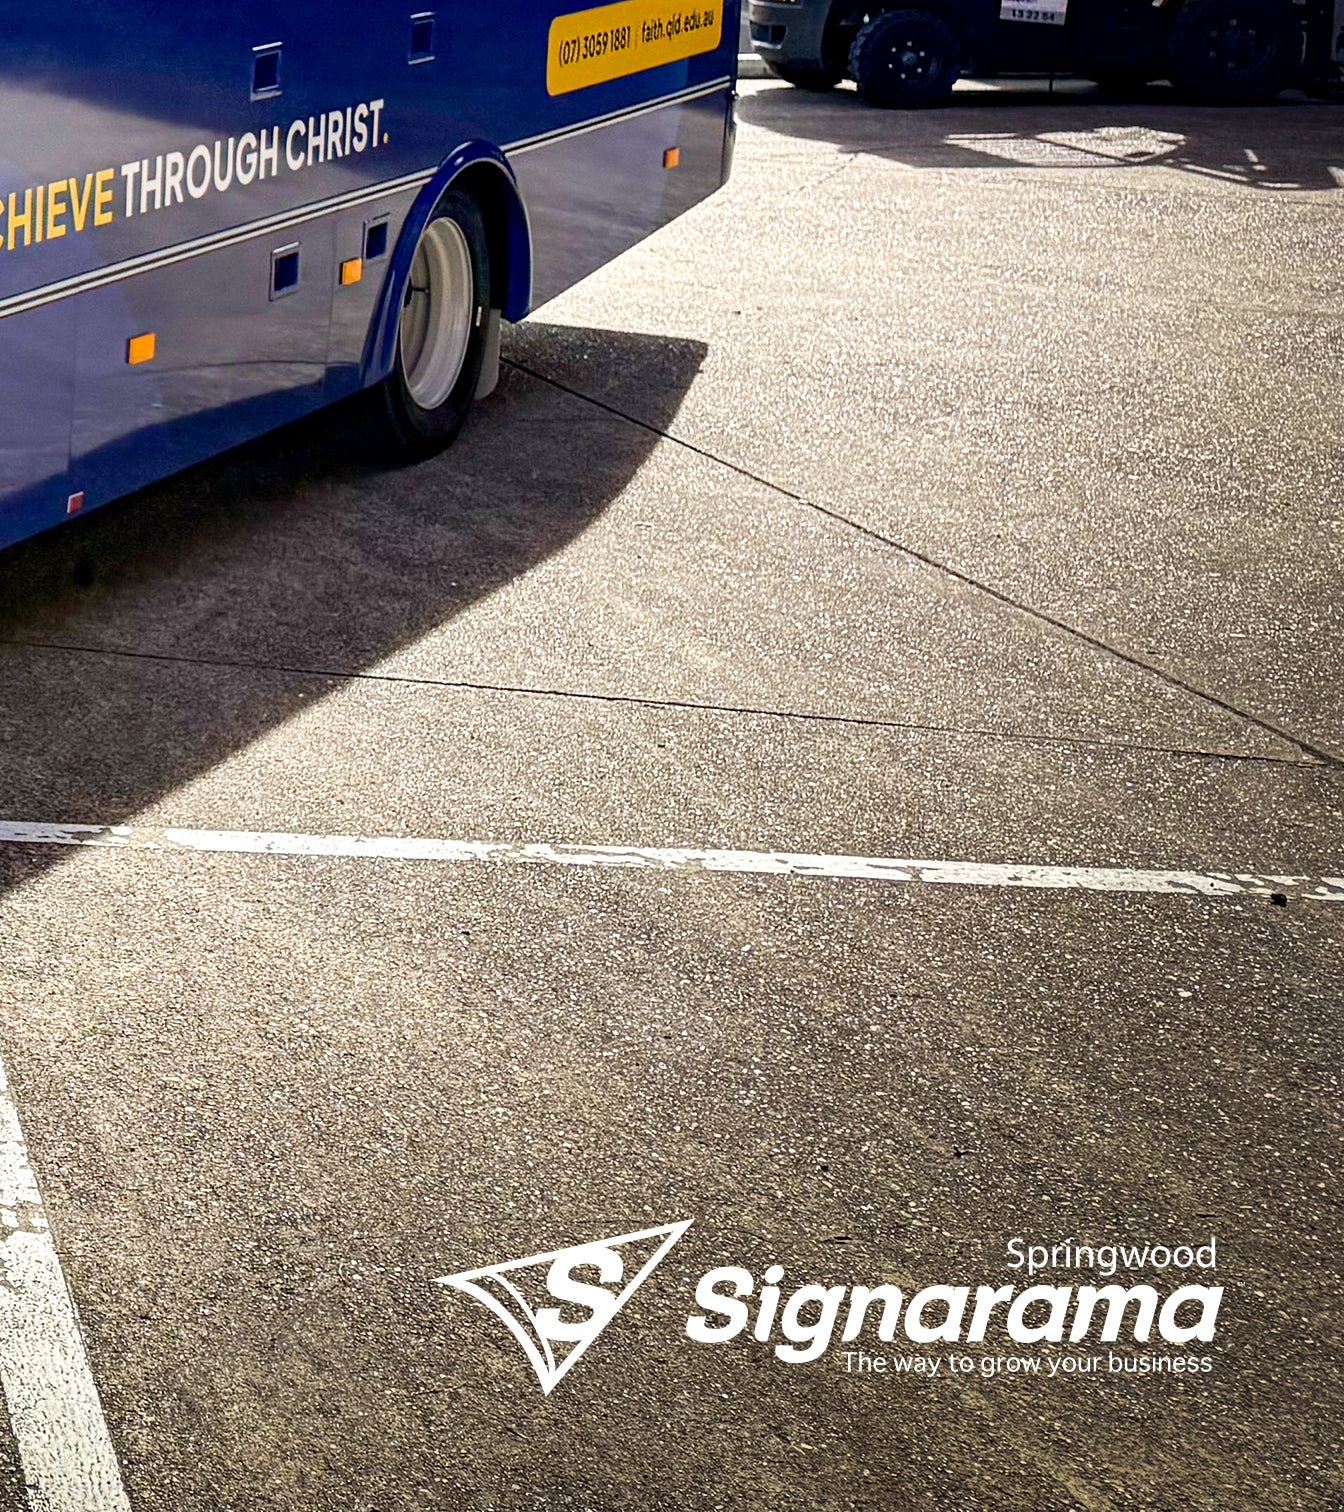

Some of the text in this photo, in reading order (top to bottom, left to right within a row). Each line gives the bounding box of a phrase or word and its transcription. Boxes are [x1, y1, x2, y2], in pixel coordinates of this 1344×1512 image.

[558, 9, 714, 67] (07) 3059 1881 faith.qld.edu.au
[122, 126, 280, 217] THROUGH
[285, 98, 389, 171] CHRIST.
